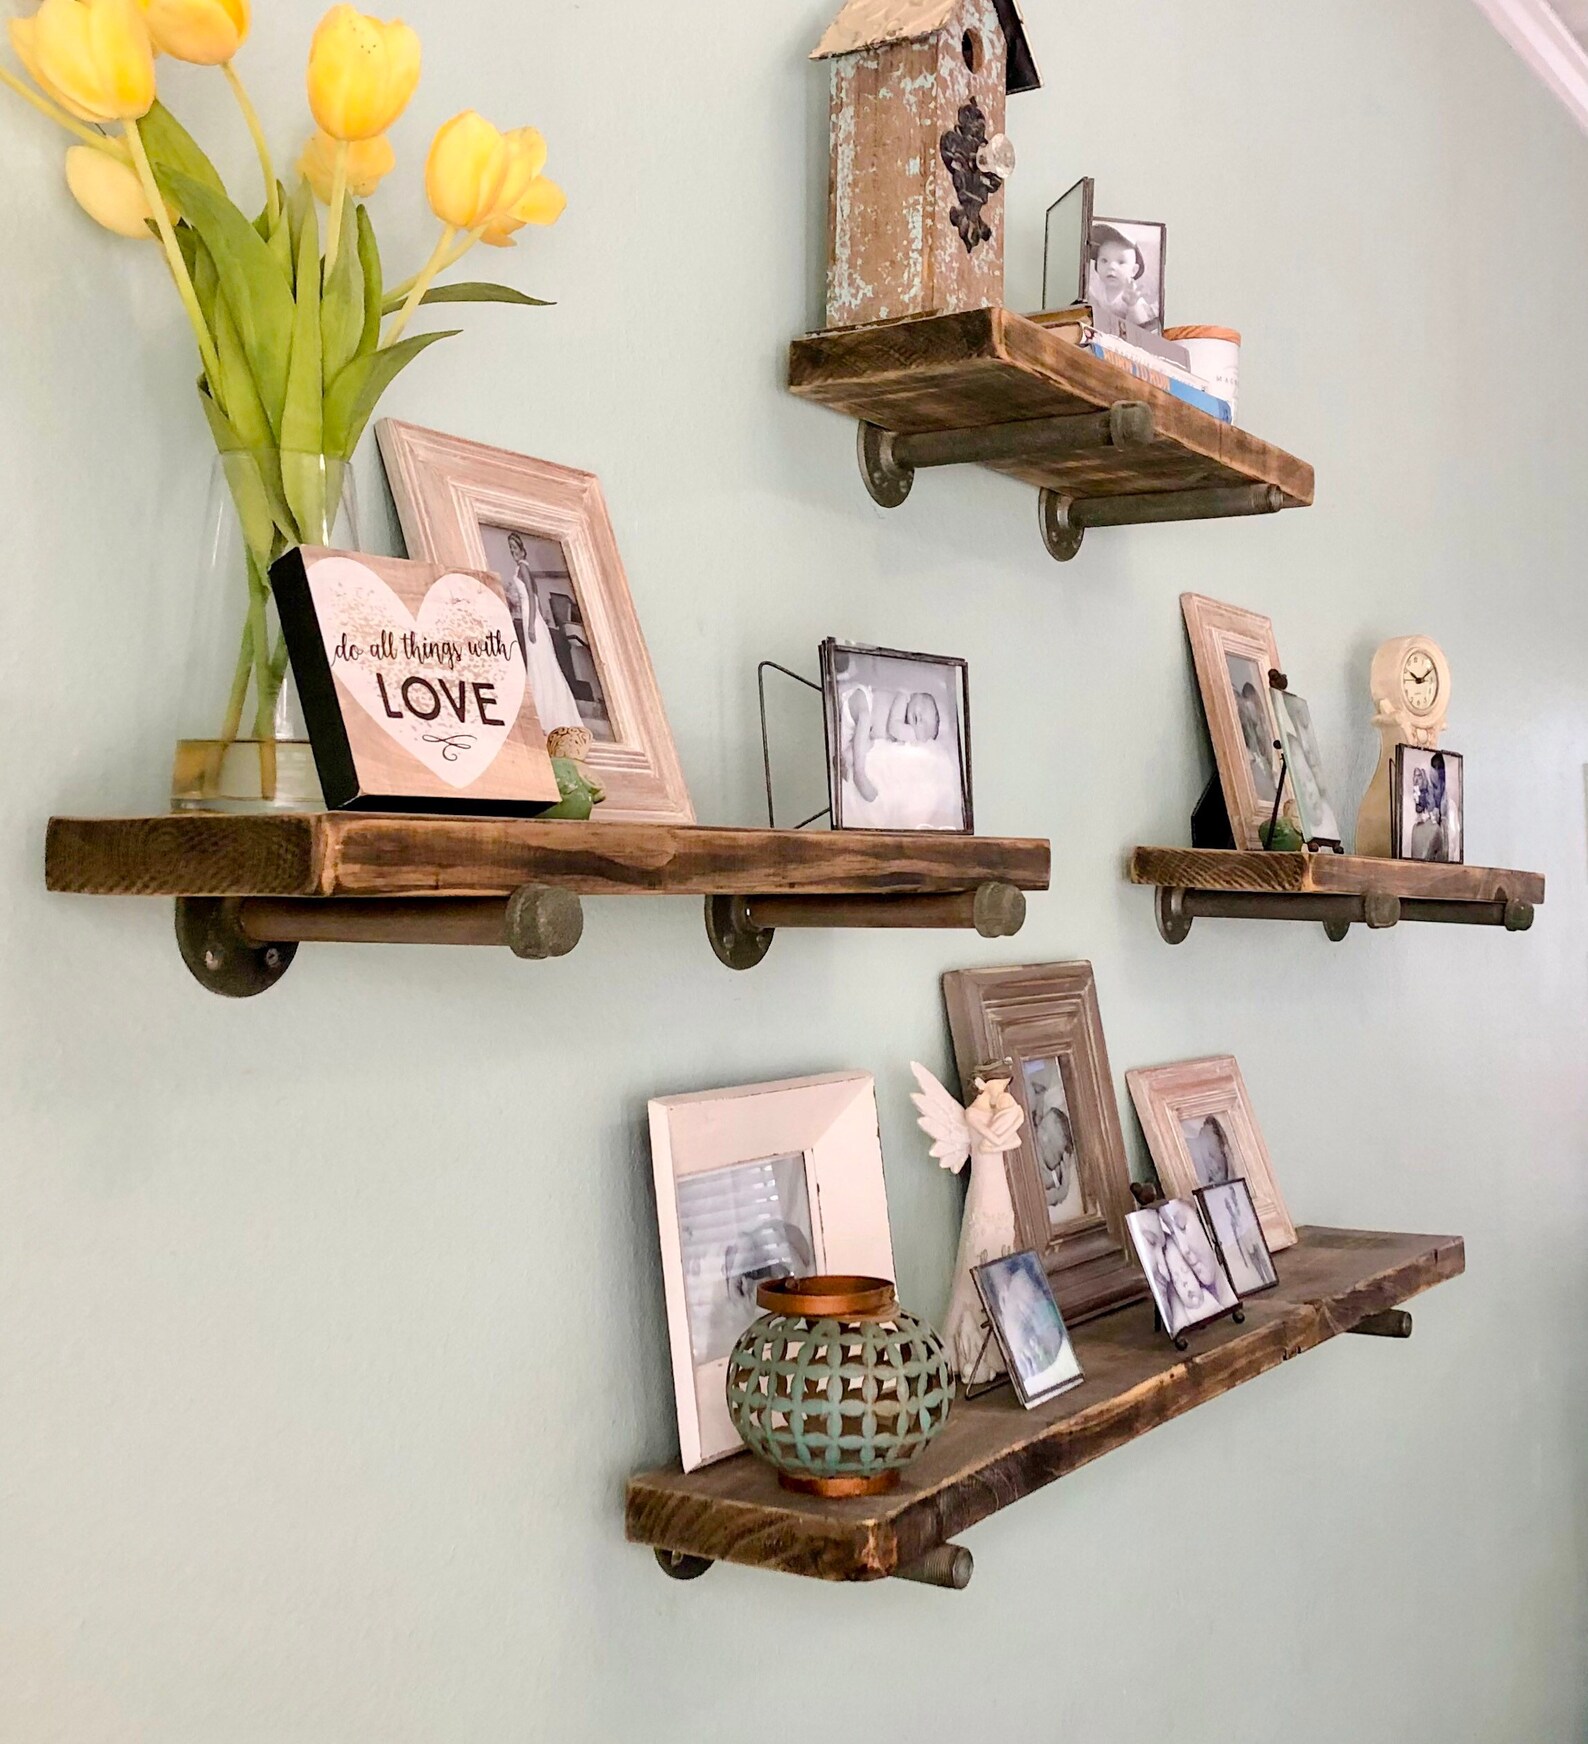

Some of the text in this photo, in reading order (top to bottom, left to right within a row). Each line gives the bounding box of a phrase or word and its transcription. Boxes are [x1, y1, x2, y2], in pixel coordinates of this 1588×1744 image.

[331, 629, 518, 670] do all things with
[376, 672, 505, 726] LOVE
